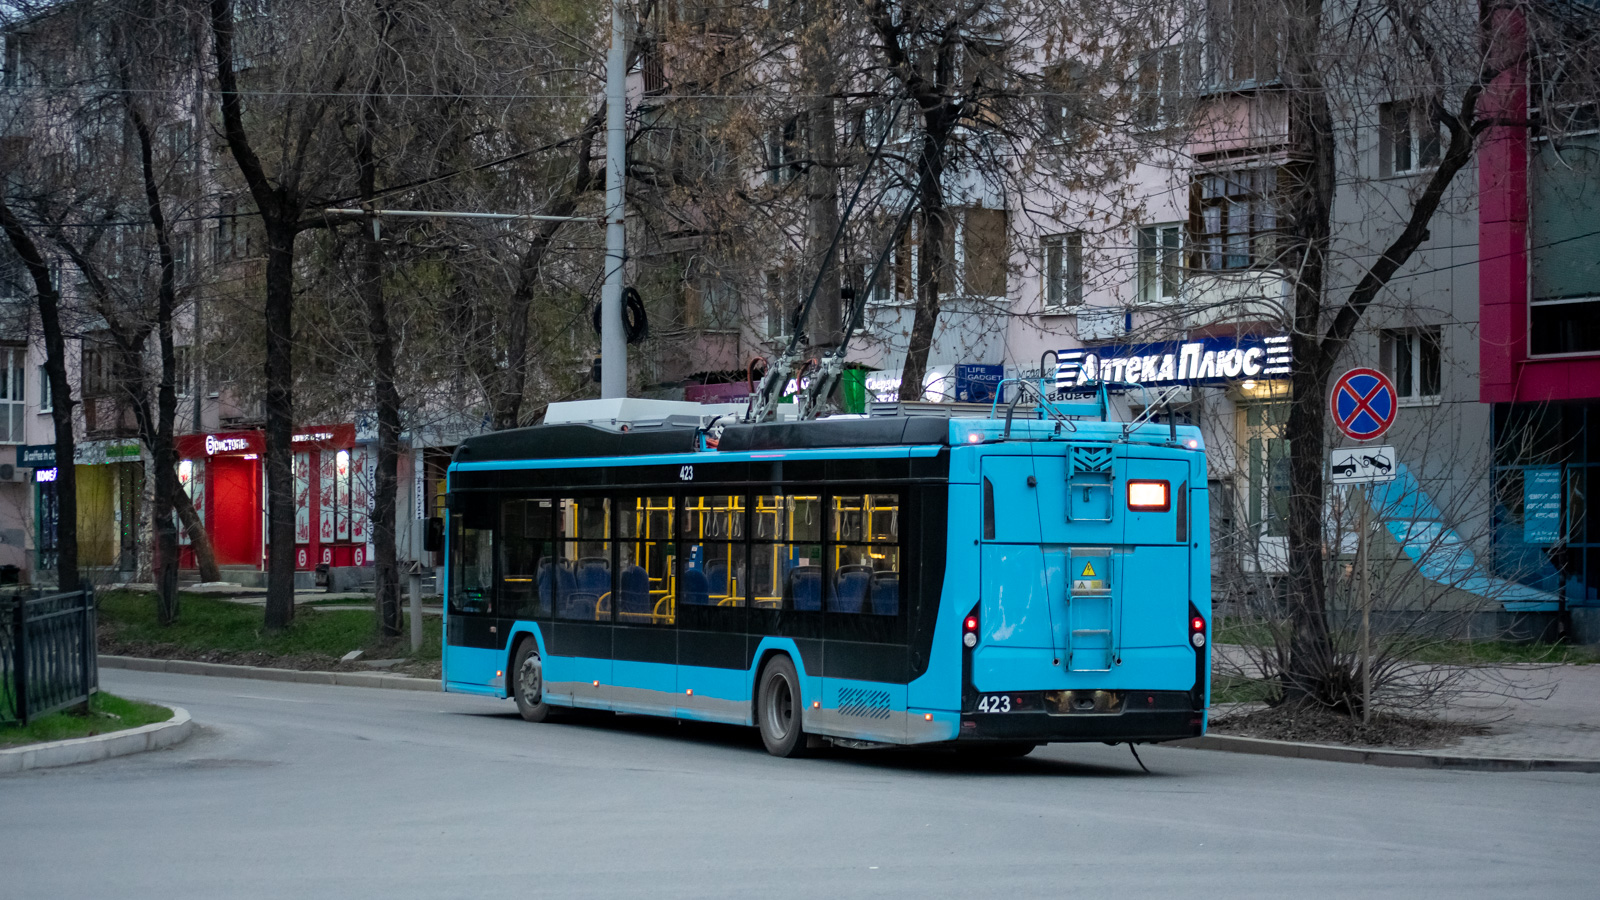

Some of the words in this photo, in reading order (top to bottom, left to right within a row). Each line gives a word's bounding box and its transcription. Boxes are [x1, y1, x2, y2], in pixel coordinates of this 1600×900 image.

[205, 435, 248, 455] Бристоль
[679, 466, 694, 481] 423
[979, 696, 1010, 713] 423
